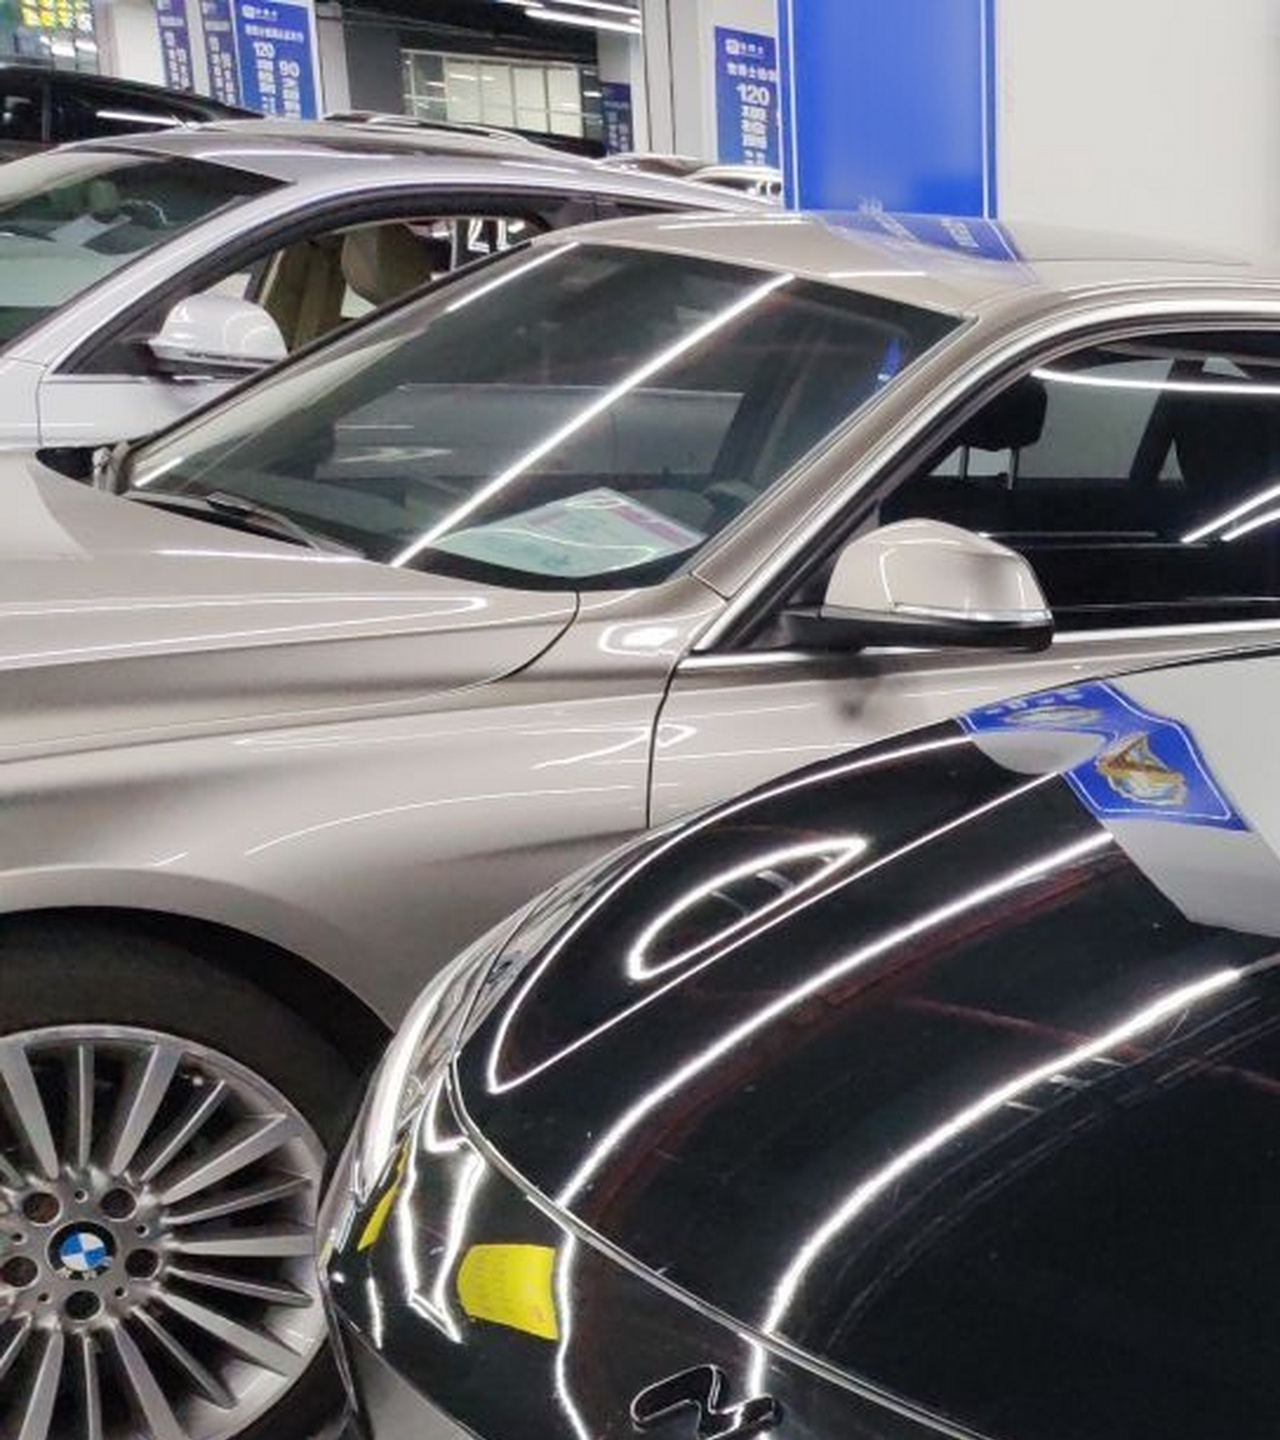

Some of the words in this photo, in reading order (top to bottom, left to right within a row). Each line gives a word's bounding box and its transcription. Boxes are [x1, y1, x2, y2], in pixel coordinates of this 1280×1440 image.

[253, 41, 275, 58] 120
[280, 60, 300, 78] 90
[736, 82, 770, 107] 120
